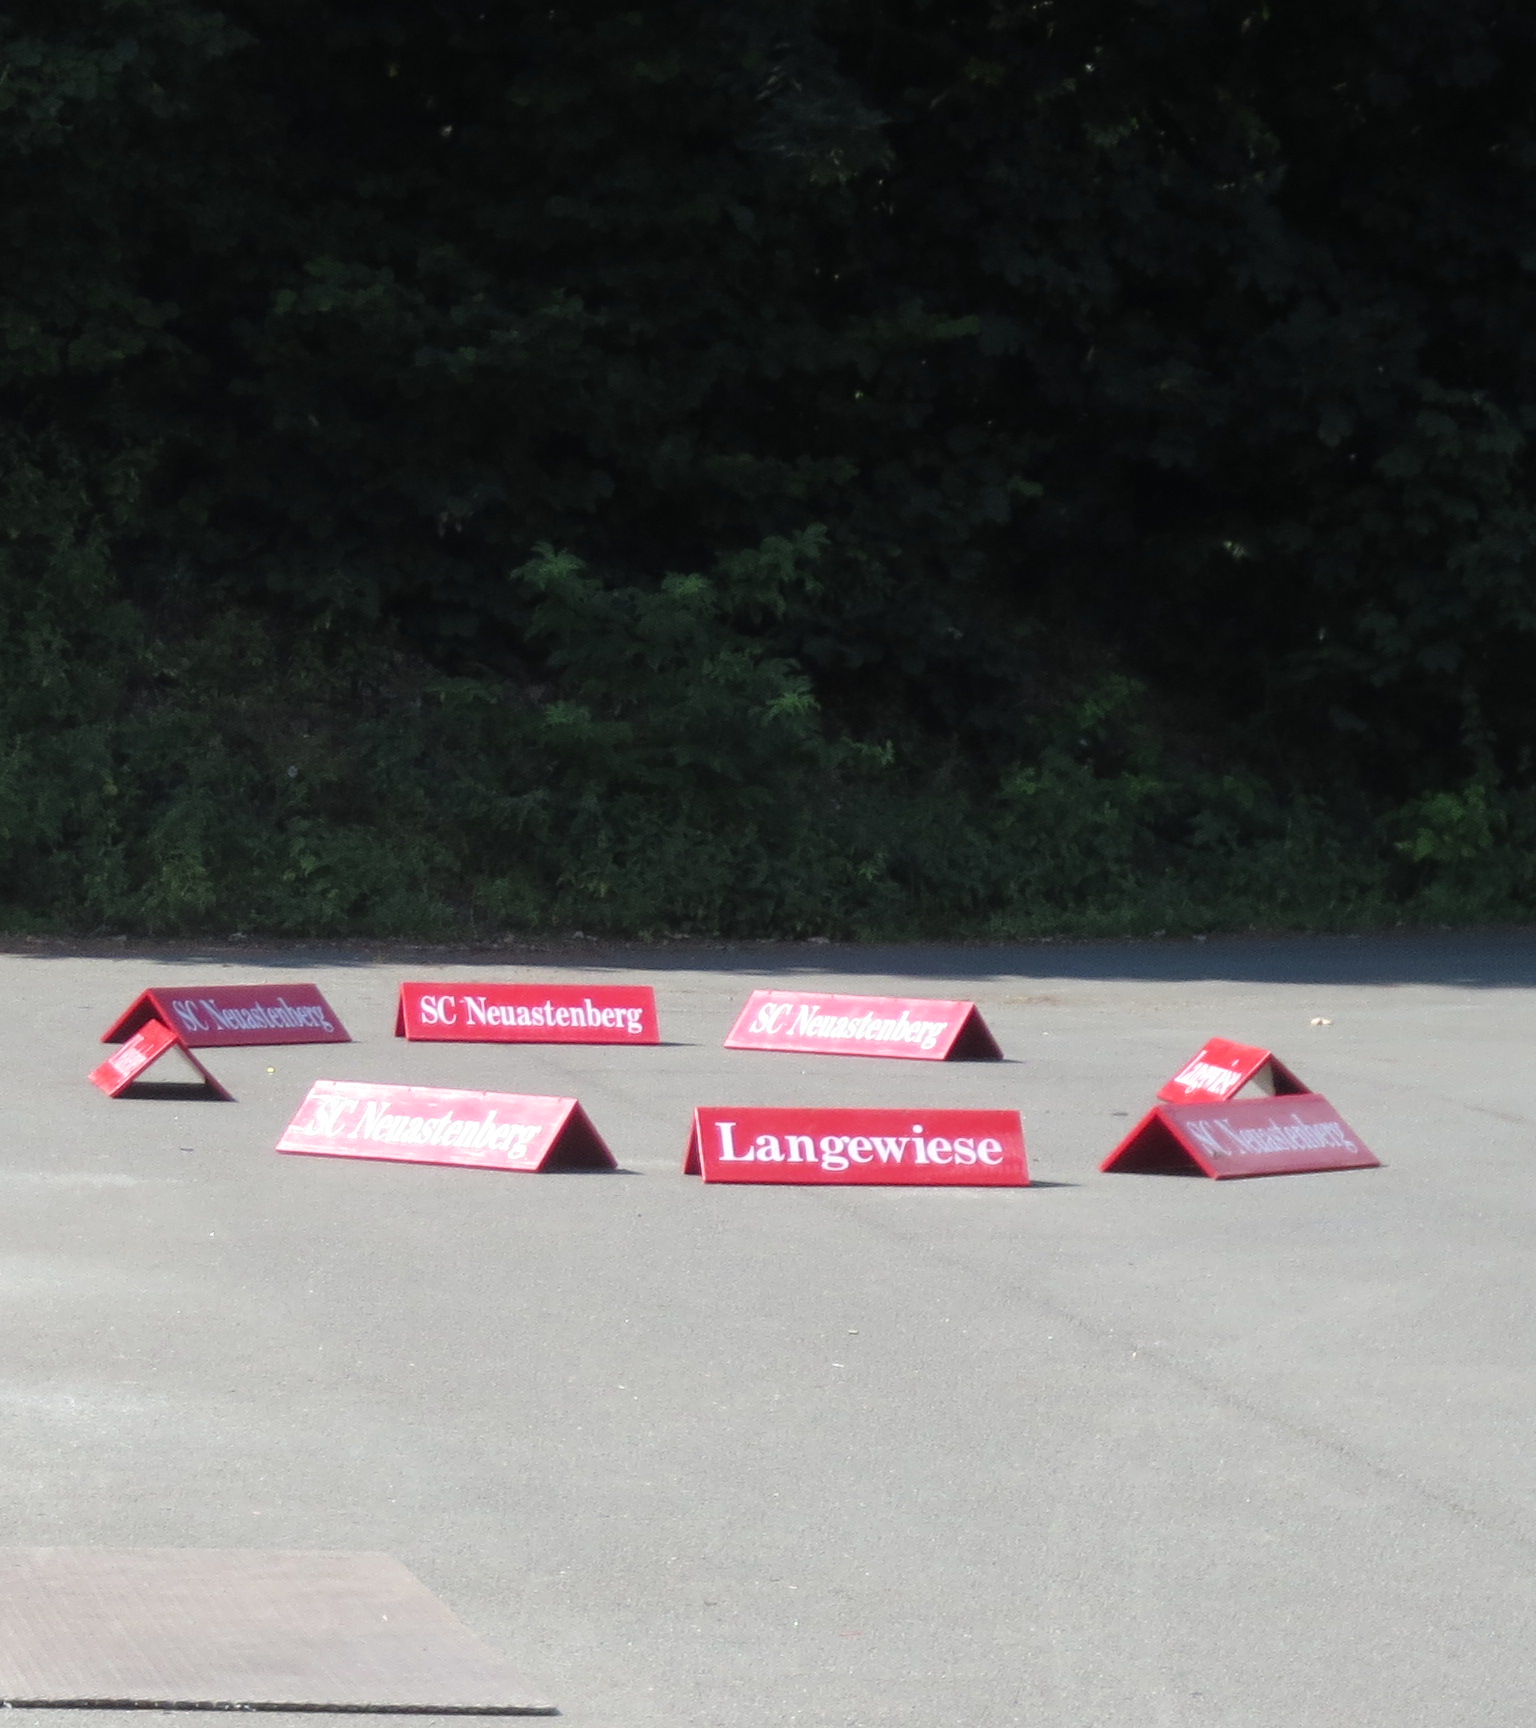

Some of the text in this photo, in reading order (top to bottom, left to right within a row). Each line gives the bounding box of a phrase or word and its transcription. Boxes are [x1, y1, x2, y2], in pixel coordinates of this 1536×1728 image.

[172, 997, 335, 1032] SC Neuastenberg
[420, 995, 643, 1034] SC Neuastenberg
[749, 1002, 948, 1051] SC Neuastenberg
[301, 1098, 543, 1160] SC Neuastenberg
[714, 1121, 1004, 1172] Langewiese
[1186, 1119, 1228, 1157] SC
